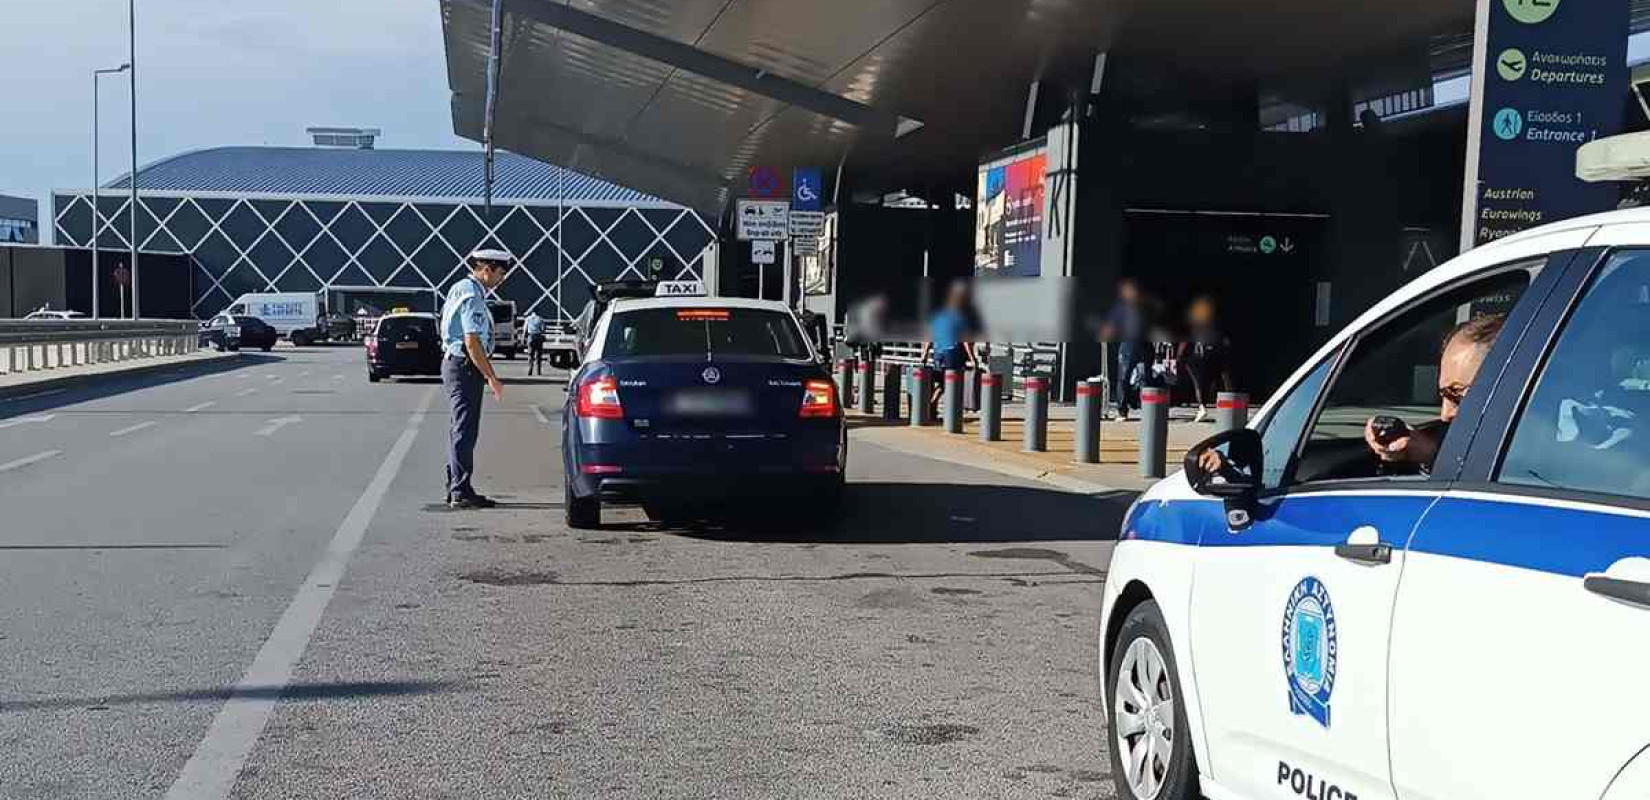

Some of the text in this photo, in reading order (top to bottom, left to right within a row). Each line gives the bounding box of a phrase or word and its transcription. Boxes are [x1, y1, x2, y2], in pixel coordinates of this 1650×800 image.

[1531, 68, 1605, 84] Departures
[1527, 128, 1585, 141] Entrance
[1484, 188, 1534, 200] Austrian
[1481, 208, 1541, 221] Eurowings
[664, 284, 697, 294] TAXI
